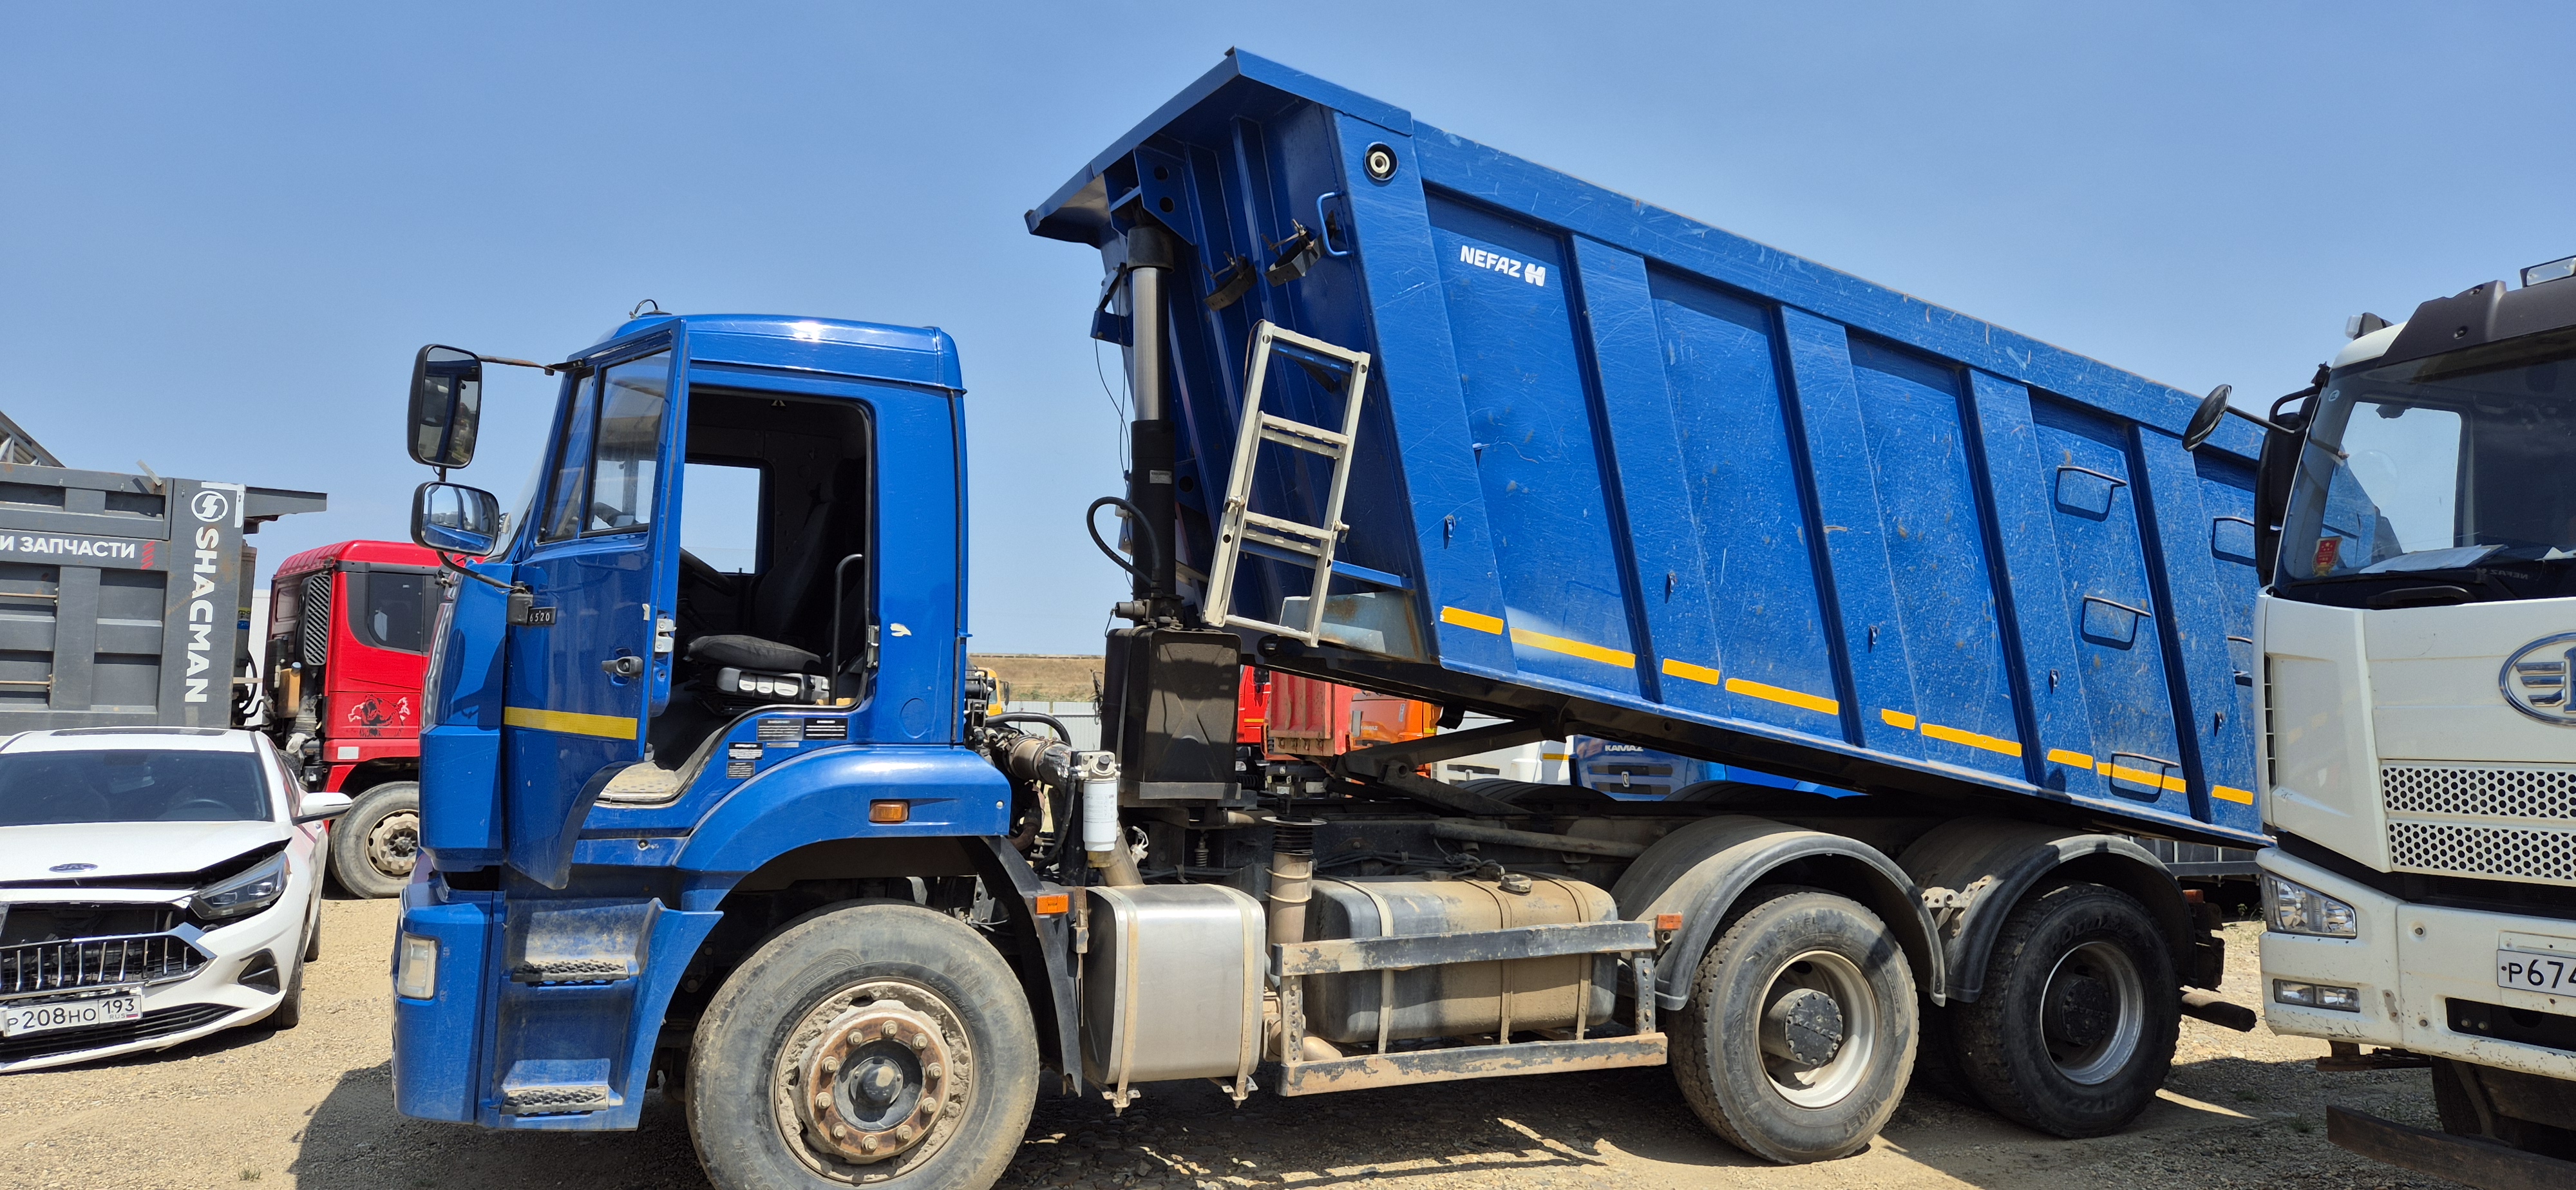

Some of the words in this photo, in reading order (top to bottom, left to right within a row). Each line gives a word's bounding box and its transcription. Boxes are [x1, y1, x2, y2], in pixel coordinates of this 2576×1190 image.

[1459, 245, 1521, 278] NEFAZ
[0, 535, 14, 551] И
[20, 536, 135, 559] ЗАПЧАСТИ
[185, 526, 219, 703] SHACMAN
[529, 612, 550, 622] 6520
[7, 1007, 97, 1032] Р208НО
[102, 998, 135, 1014] 193
